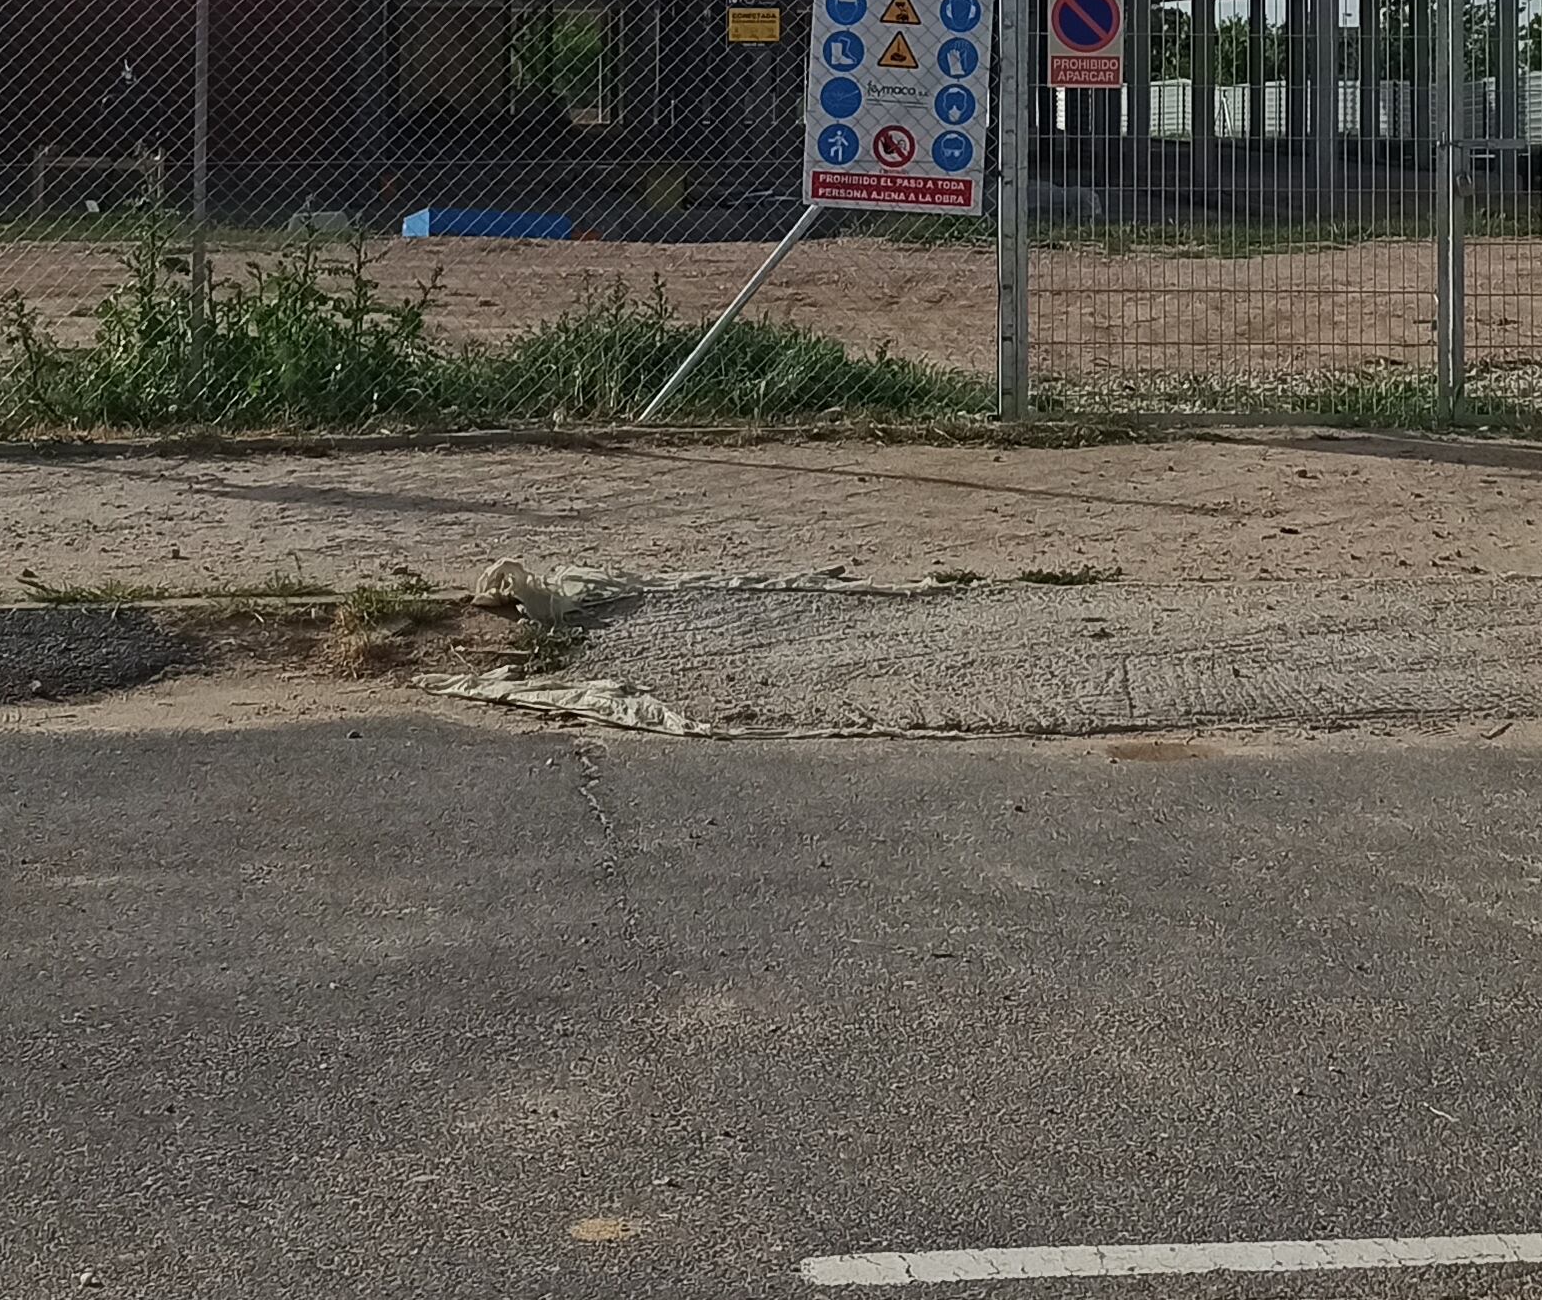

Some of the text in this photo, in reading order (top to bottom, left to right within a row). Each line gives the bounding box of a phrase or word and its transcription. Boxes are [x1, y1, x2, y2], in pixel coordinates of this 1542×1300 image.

[1053, 58, 1118, 70] PROHIBIDO
[1057, 71, 1114, 81] APARCAR
[819, 173, 965, 190] PROHIBIDO EL PASO A TODA
[818, 188, 965, 204] PERSONA AJENA A LA OBRA
